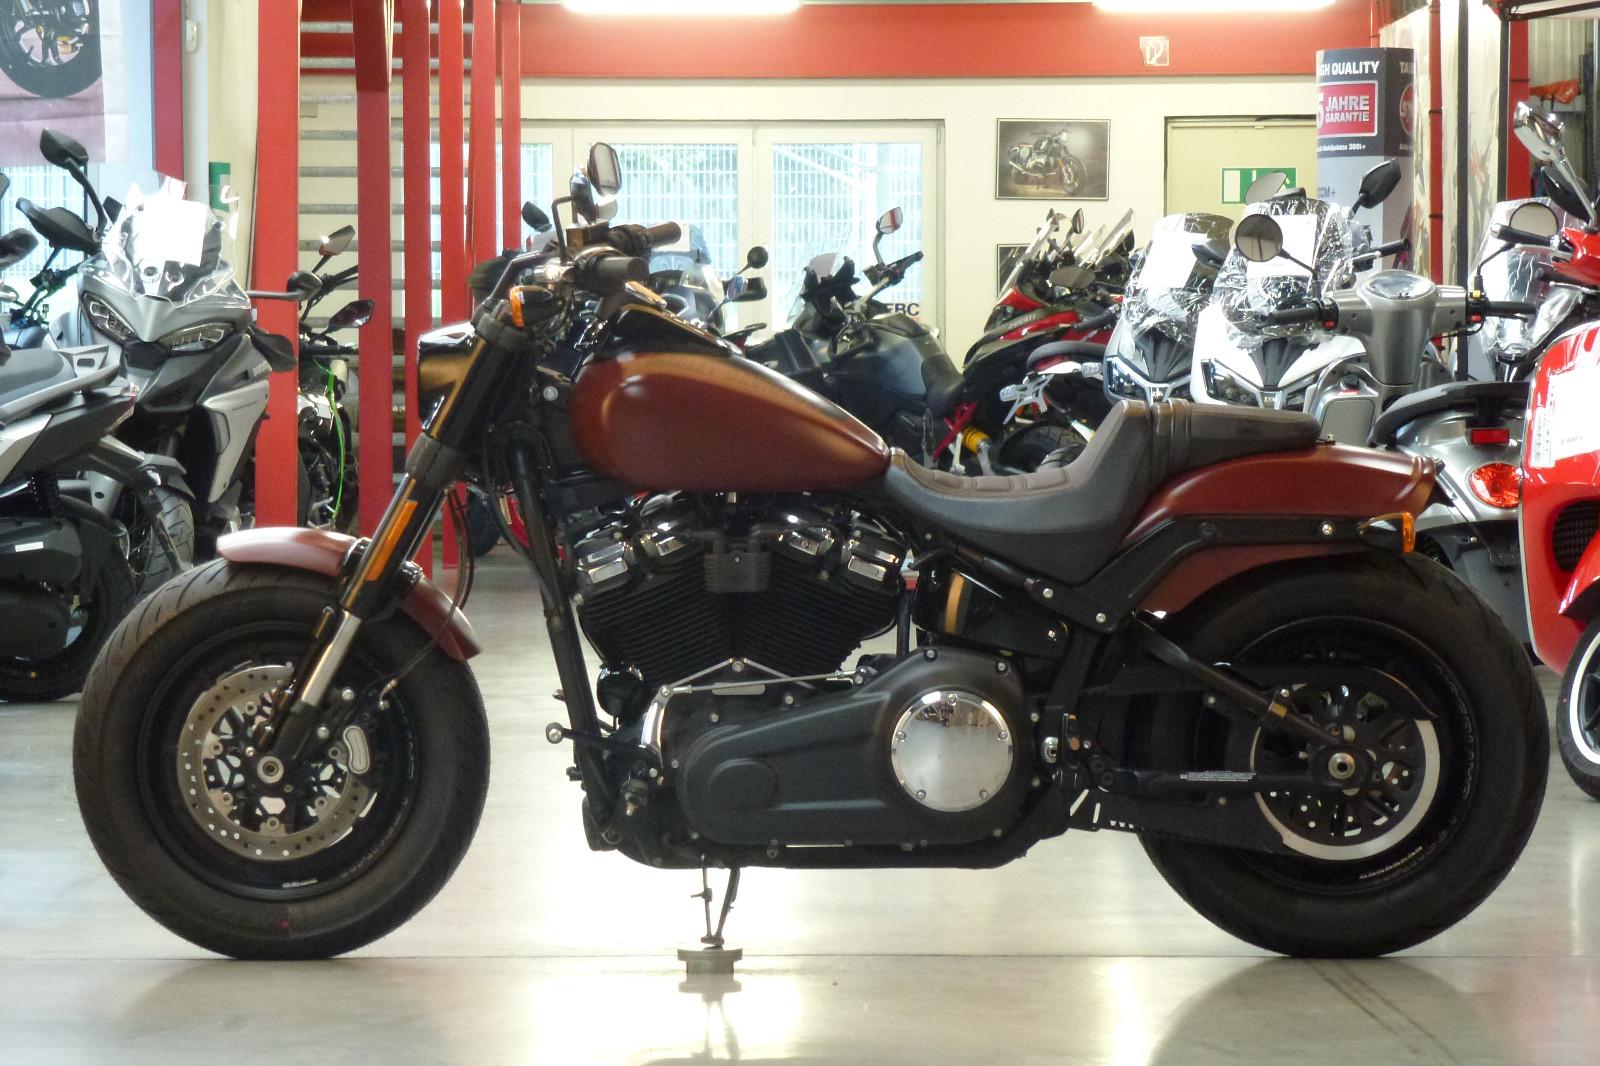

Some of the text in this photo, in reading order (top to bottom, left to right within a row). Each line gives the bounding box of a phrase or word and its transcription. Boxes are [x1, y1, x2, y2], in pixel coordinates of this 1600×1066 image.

[1331, 61, 1380, 75] QUALITY
[1326, 95, 1370, 111] JAHRE
[1325, 111, 1370, 123] GARANTIE
